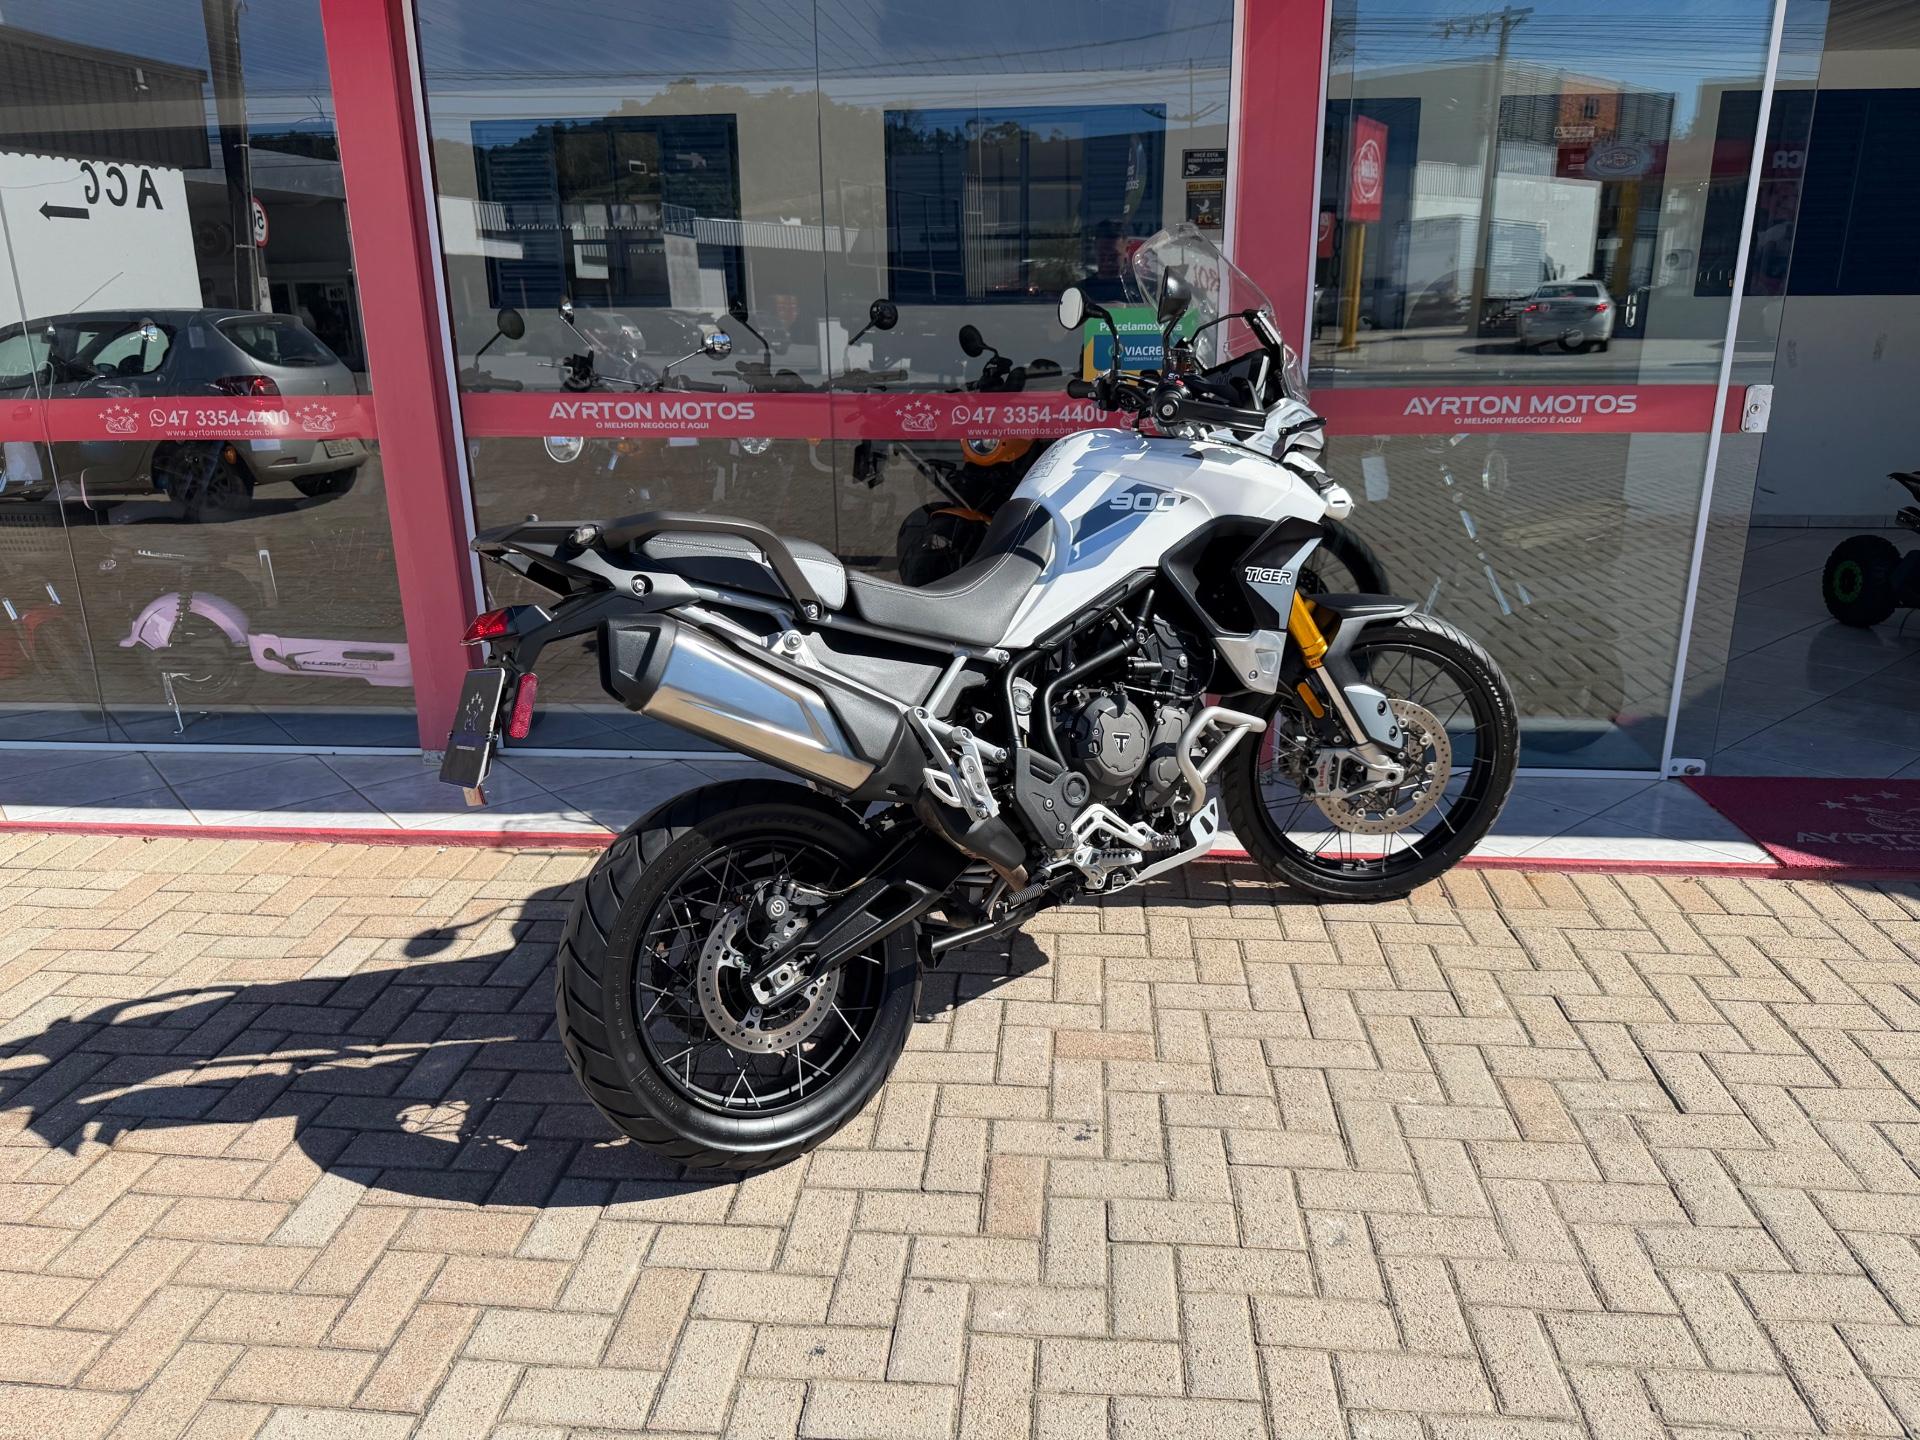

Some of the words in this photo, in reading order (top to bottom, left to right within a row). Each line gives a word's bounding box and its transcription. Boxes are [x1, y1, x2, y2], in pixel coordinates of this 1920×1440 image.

[1124, 345, 1165, 357] VIACRE
[549, 402, 652, 420] AYRTON
[660, 402, 756, 420] MOTOS
[1403, 396, 1520, 415] AYRTON
[1529, 394, 1638, 415] MOTOS
[168, 410, 189, 427] 47
[196, 409, 290, 427] 3354-4400
[972, 407, 997, 424] 47
[1003, 405, 1108, 424] 3354-4400
[1454, 417, 1463, 425] O
[1463, 416, 1504, 425] MELHOR
[1504, 415, 1548, 425] NEGÓCIO
[1549, 415, 1556, 424] É
[1556, 416, 1582, 424] AQUI
[166, 428, 273, 438] www.ayrtonmotos.com.br
[680, 420, 686, 429] É
[1109, 492, 1177, 512] 900
[1245, 566, 1293, 585] TIGER
